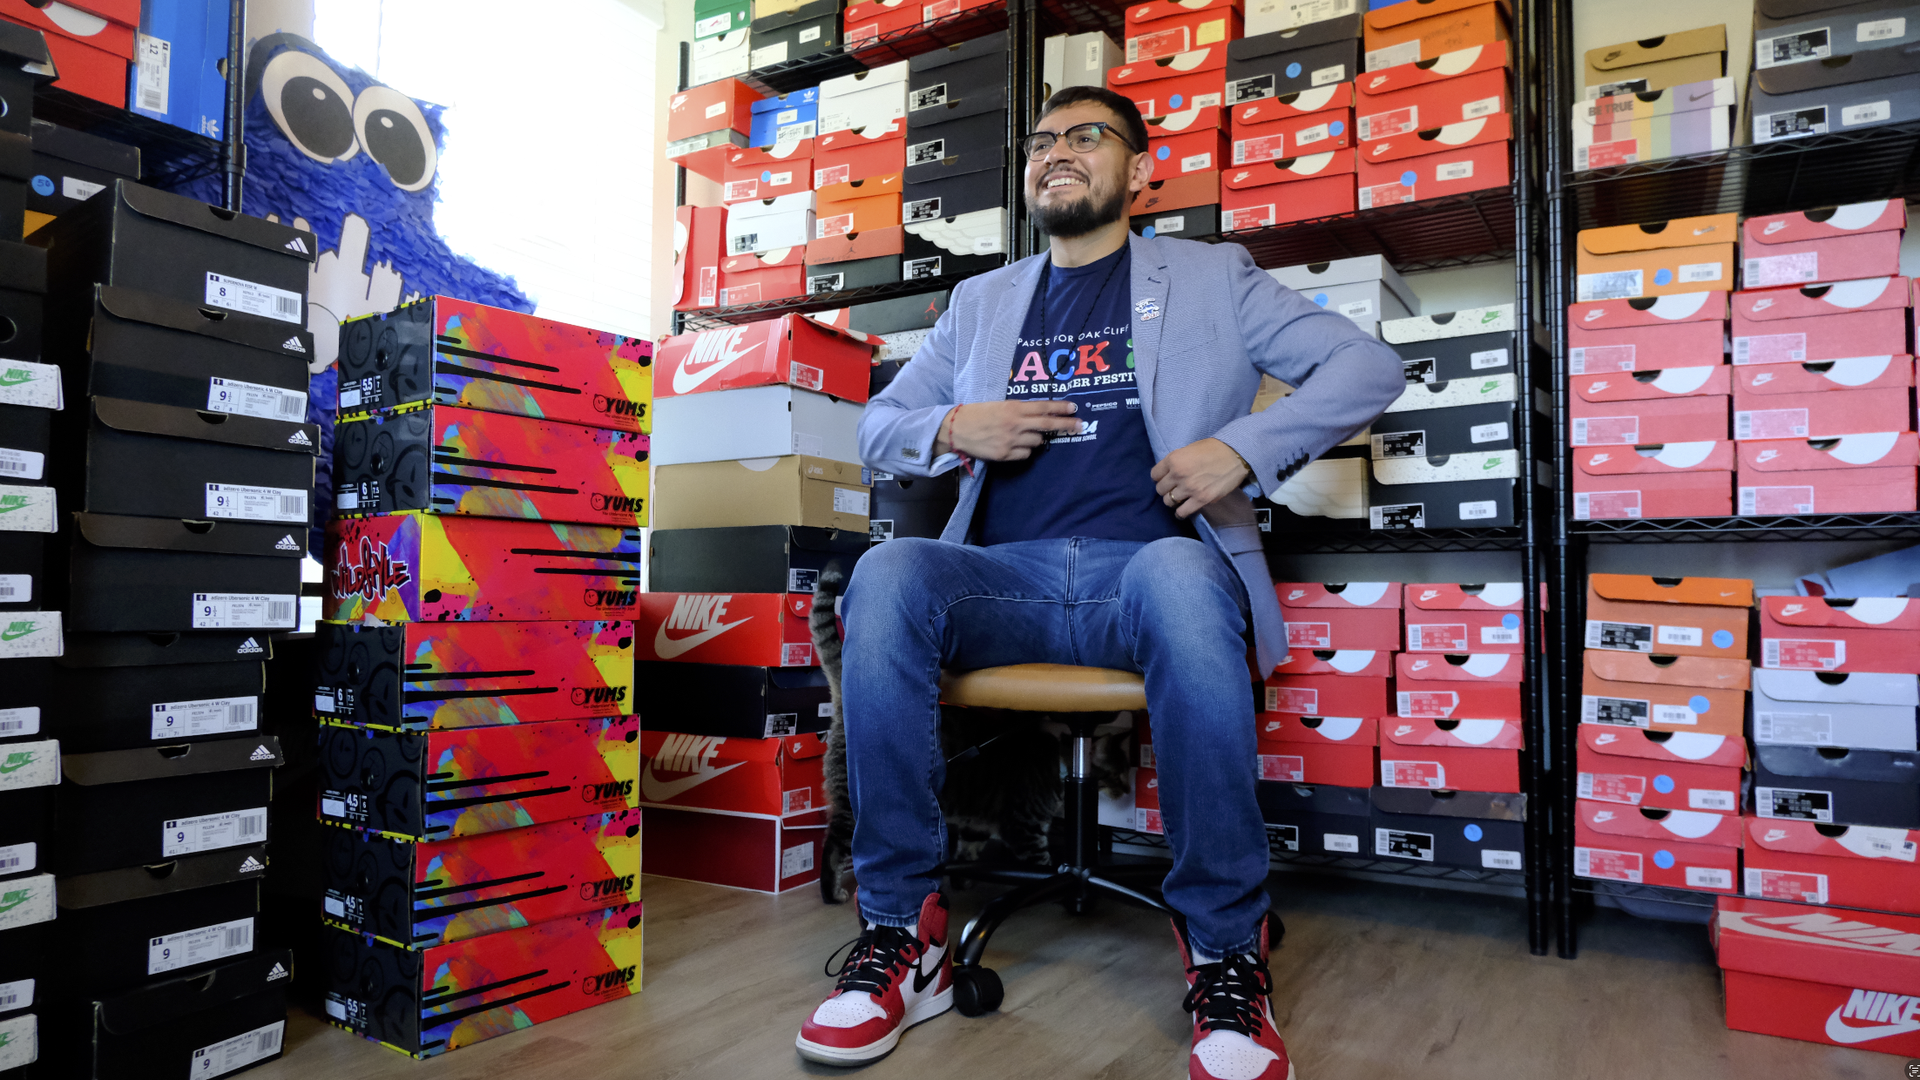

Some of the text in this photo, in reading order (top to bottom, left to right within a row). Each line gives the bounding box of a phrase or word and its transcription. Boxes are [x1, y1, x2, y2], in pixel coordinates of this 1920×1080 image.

[149, 43, 159, 55] 12
[1588, 100, 1634, 117] BE TRUE
[219, 287, 226, 297] 8
[1053, 334, 1074, 343] FOR
[1078, 330, 1101, 341] OAK
[1103, 324, 1130, 335] CLIFF
[686, 325, 749, 366] NIKE
[1009, 340, 1111, 382] ACK
[4, 368, 33, 379] NIKE
[362, 378, 373, 392] 5.5
[1006, 384, 1029, 396] OOL
[1031, 377, 1091, 393] SNEAKER
[606, 397, 647, 418] YUMS
[288, 438, 312, 447] adidas
[362, 483, 368, 496] 6
[0, 494, 29, 506] NIKE
[603, 495, 644, 513] YUMS
[598, 590, 637, 606] YUMS
[667, 595, 733, 630] NIKE
[7, 621, 35, 632] NIKE
[337, 688, 343, 701] 6
[584, 686, 627, 704] YUMS
[166, 716, 174, 727] 9
[6, 751, 34, 764] NIKE
[250, 753, 275, 761] adidas
[653, 733, 727, 773] NIKE
[594, 780, 633, 801] YUMS
[346, 794, 359, 808] 4.5
[177, 831, 185, 843] 9
[239, 864, 265, 874] adidas
[594, 875, 634, 898] YUMS
[1, 888, 31, 903] NIKE
[345, 896, 356, 909] 4.5
[163, 948, 171, 960] 9
[595, 965, 636, 991] YUMS
[347, 998, 358, 1013] 5.5
[203, 1058, 210, 1070] 9
